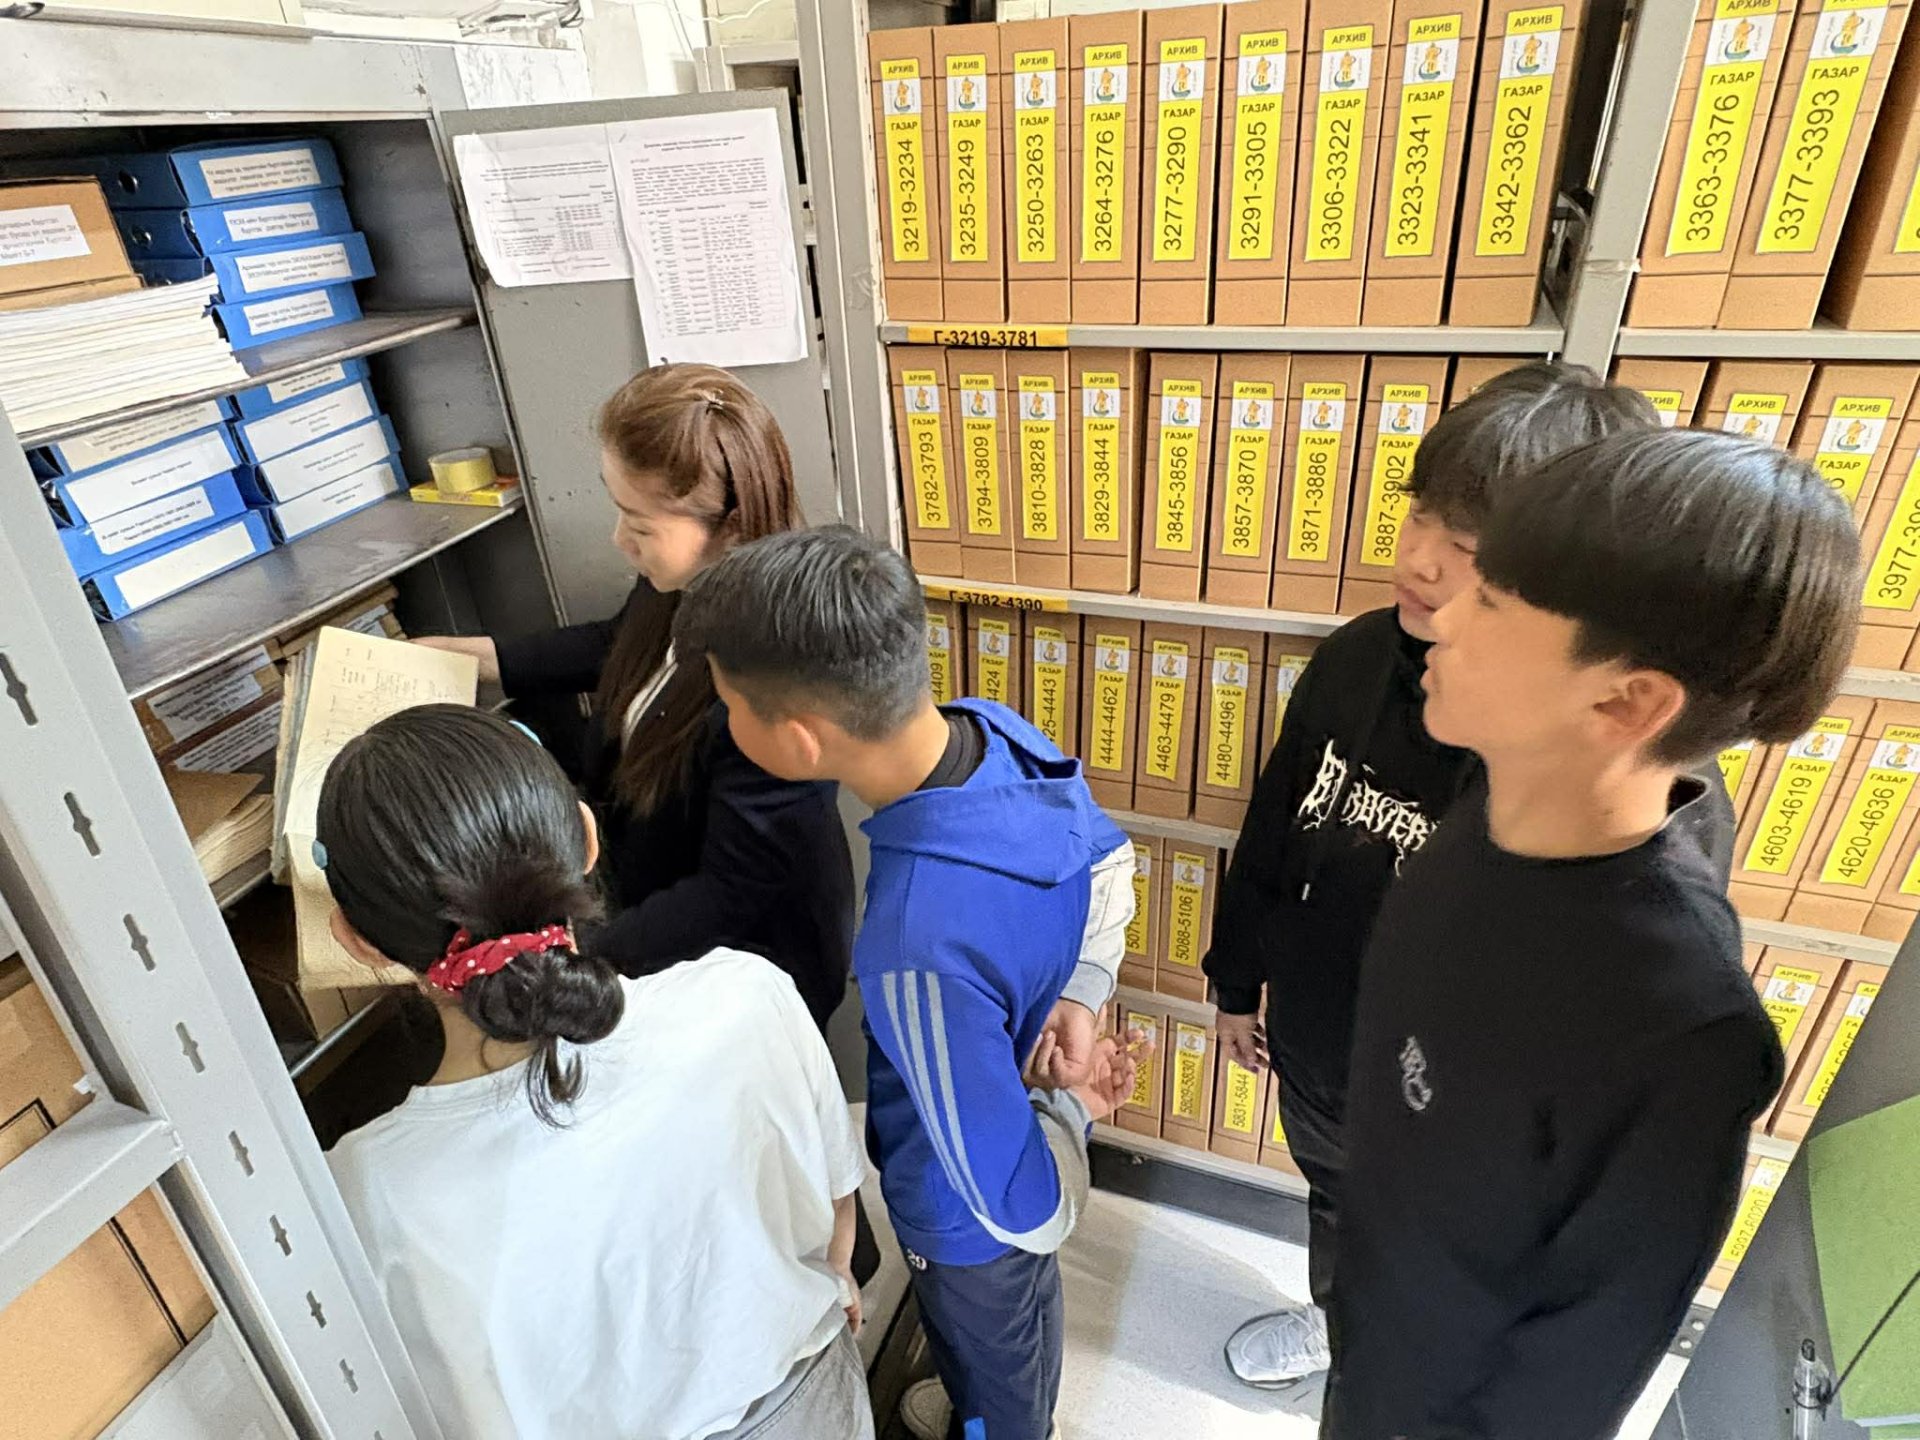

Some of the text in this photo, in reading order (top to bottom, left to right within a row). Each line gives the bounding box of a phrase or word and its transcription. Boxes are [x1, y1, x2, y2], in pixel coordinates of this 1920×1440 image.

[1514, 14, 1552, 28] АРХИВ
[1416, 22, 1452, 34] АРХИВ
[1246, 38, 1278, 50] АРХИВ
[1332, 32, 1366, 44] АРХИВ
[1092, 50, 1122, 60] АРХИВ
[1166, 46, 1198, 56] АРХИВ
[952, 60, 980, 70] АРХИВ
[1020, 56, 1048, 66] АРХИВ
[888, 64, 914, 74] АРХИВ
[1812, 66, 1860, 80] ГАЗАР
[1710, 72, 1754, 86] ГАЗАР
[1408, 90, 1444, 102] ГАЗАР
[1504, 84, 1544, 98] ГАЗАР
[1242, 102, 1276, 114] ГАЗАР
[1326, 98, 1360, 110] ГАЗАР
[1090, 112, 1122, 122] ГАЗАР
[1164, 108, 1196, 118] ГАЗАР
[890, 120, 918, 130] ГАЗАР
[952, 118, 980, 128] ГАЗАР
[1020, 116, 1050, 126] ГАЗАР
[1686, 94, 1740, 240] 3363-3376
[1774, 90, 1840, 240] 3377-3393
[1398, 114, 1432, 246] 3323-3341
[1490, 106, 1532, 244] 3342-3362
[1164, 126, 1186, 250] 3277-3290
[1240, 122, 1266, 248] 3291-3305
[1320, 118, 1352, 250] 3306-3322
[898, 138, 920, 252] 3219-3234
[1026, 134, 1044, 252] 3250-3263
[1094, 130, 1114, 252] 3264-3276
[958, 140, 976, 256] 3235-3249
[933, 330, 1037, 346] Г-3219-3781
[1088, 376, 1114, 384] АРХИВ
[1168, 384, 1196, 392] АРХИВ
[1238, 386, 1268, 394] АРХИВ
[1310, 388, 1340, 396] АРХИВ
[1390, 390, 1422, 398] АРХИВ
[1738, 400, 1776, 408] АРХИВ
[1840, 404, 1880, 412] АРХИВ
[912, 418, 936, 426] ГАЗАР
[966, 422, 992, 430] ГАЗАР
[1024, 426, 1050, 434] ГАЗАР
[1166, 432, 1194, 440] ГАЗАР
[1234, 436, 1264, 444] ГАЗАР
[1306, 436, 1336, 446] ГАЗАР
[1382, 440, 1414, 448] ГАЗАР
[1820, 460, 1860, 470] ГАЗАР
[918, 432, 942, 522] 3782-3793
[974, 436, 992, 528] 3794-3809
[1030, 440, 1048, 532] 3810-3828
[1094, 438, 1110, 532] 3829-3844
[1166, 446, 1188, 542] 3845-3856
[1232, 450, 1256, 548] 3857-3870
[1300, 452, 1328, 552] 3871-3886
[1374, 456, 1406, 557] 3887-3902
[950, 591, 1042, 610] Г-3782-4390
[1038, 666, 1062, 674] ГАЗАР
[1098, 674, 1124, 684] ГАЗАР
[1156, 680, 1180, 690] ГАЗАР
[1100, 686, 1118, 764] 4444-4462
[1156, 692, 1176, 772] 4463-4479
[1216, 700, 1236, 780] 4480-4496
[1790, 762, 1826, 772] ГАЗАР
[1870, 774, 1908, 784] ГАЗАР
[1760, 778, 1812, 866] 4603-4619
[1838, 788, 1894, 878] 4620-4636
[1176, 896, 1194, 960] 5088-5106
[1780, 970, 1812, 980] АРХИВ
[1180, 1061, 1195, 1114] 5809-5830
[1232, 1074, 1248, 1128] 5831-5844
